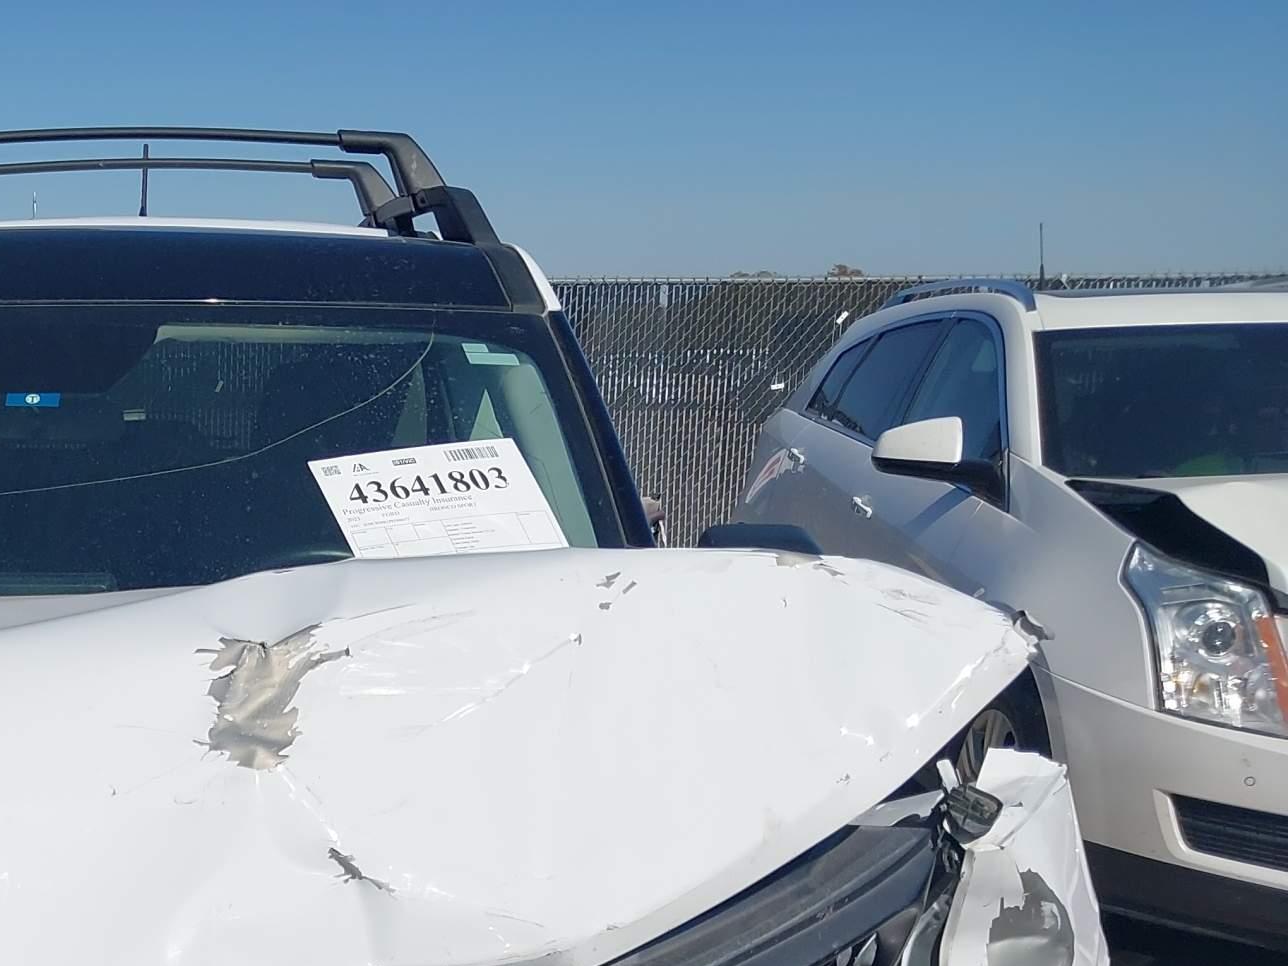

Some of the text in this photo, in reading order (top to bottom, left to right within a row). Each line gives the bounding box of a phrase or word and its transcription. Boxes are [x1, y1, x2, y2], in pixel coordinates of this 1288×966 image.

[349, 467, 509, 503] 43641803
[342, 494, 473, 516] Progressive Casualty Insurance
